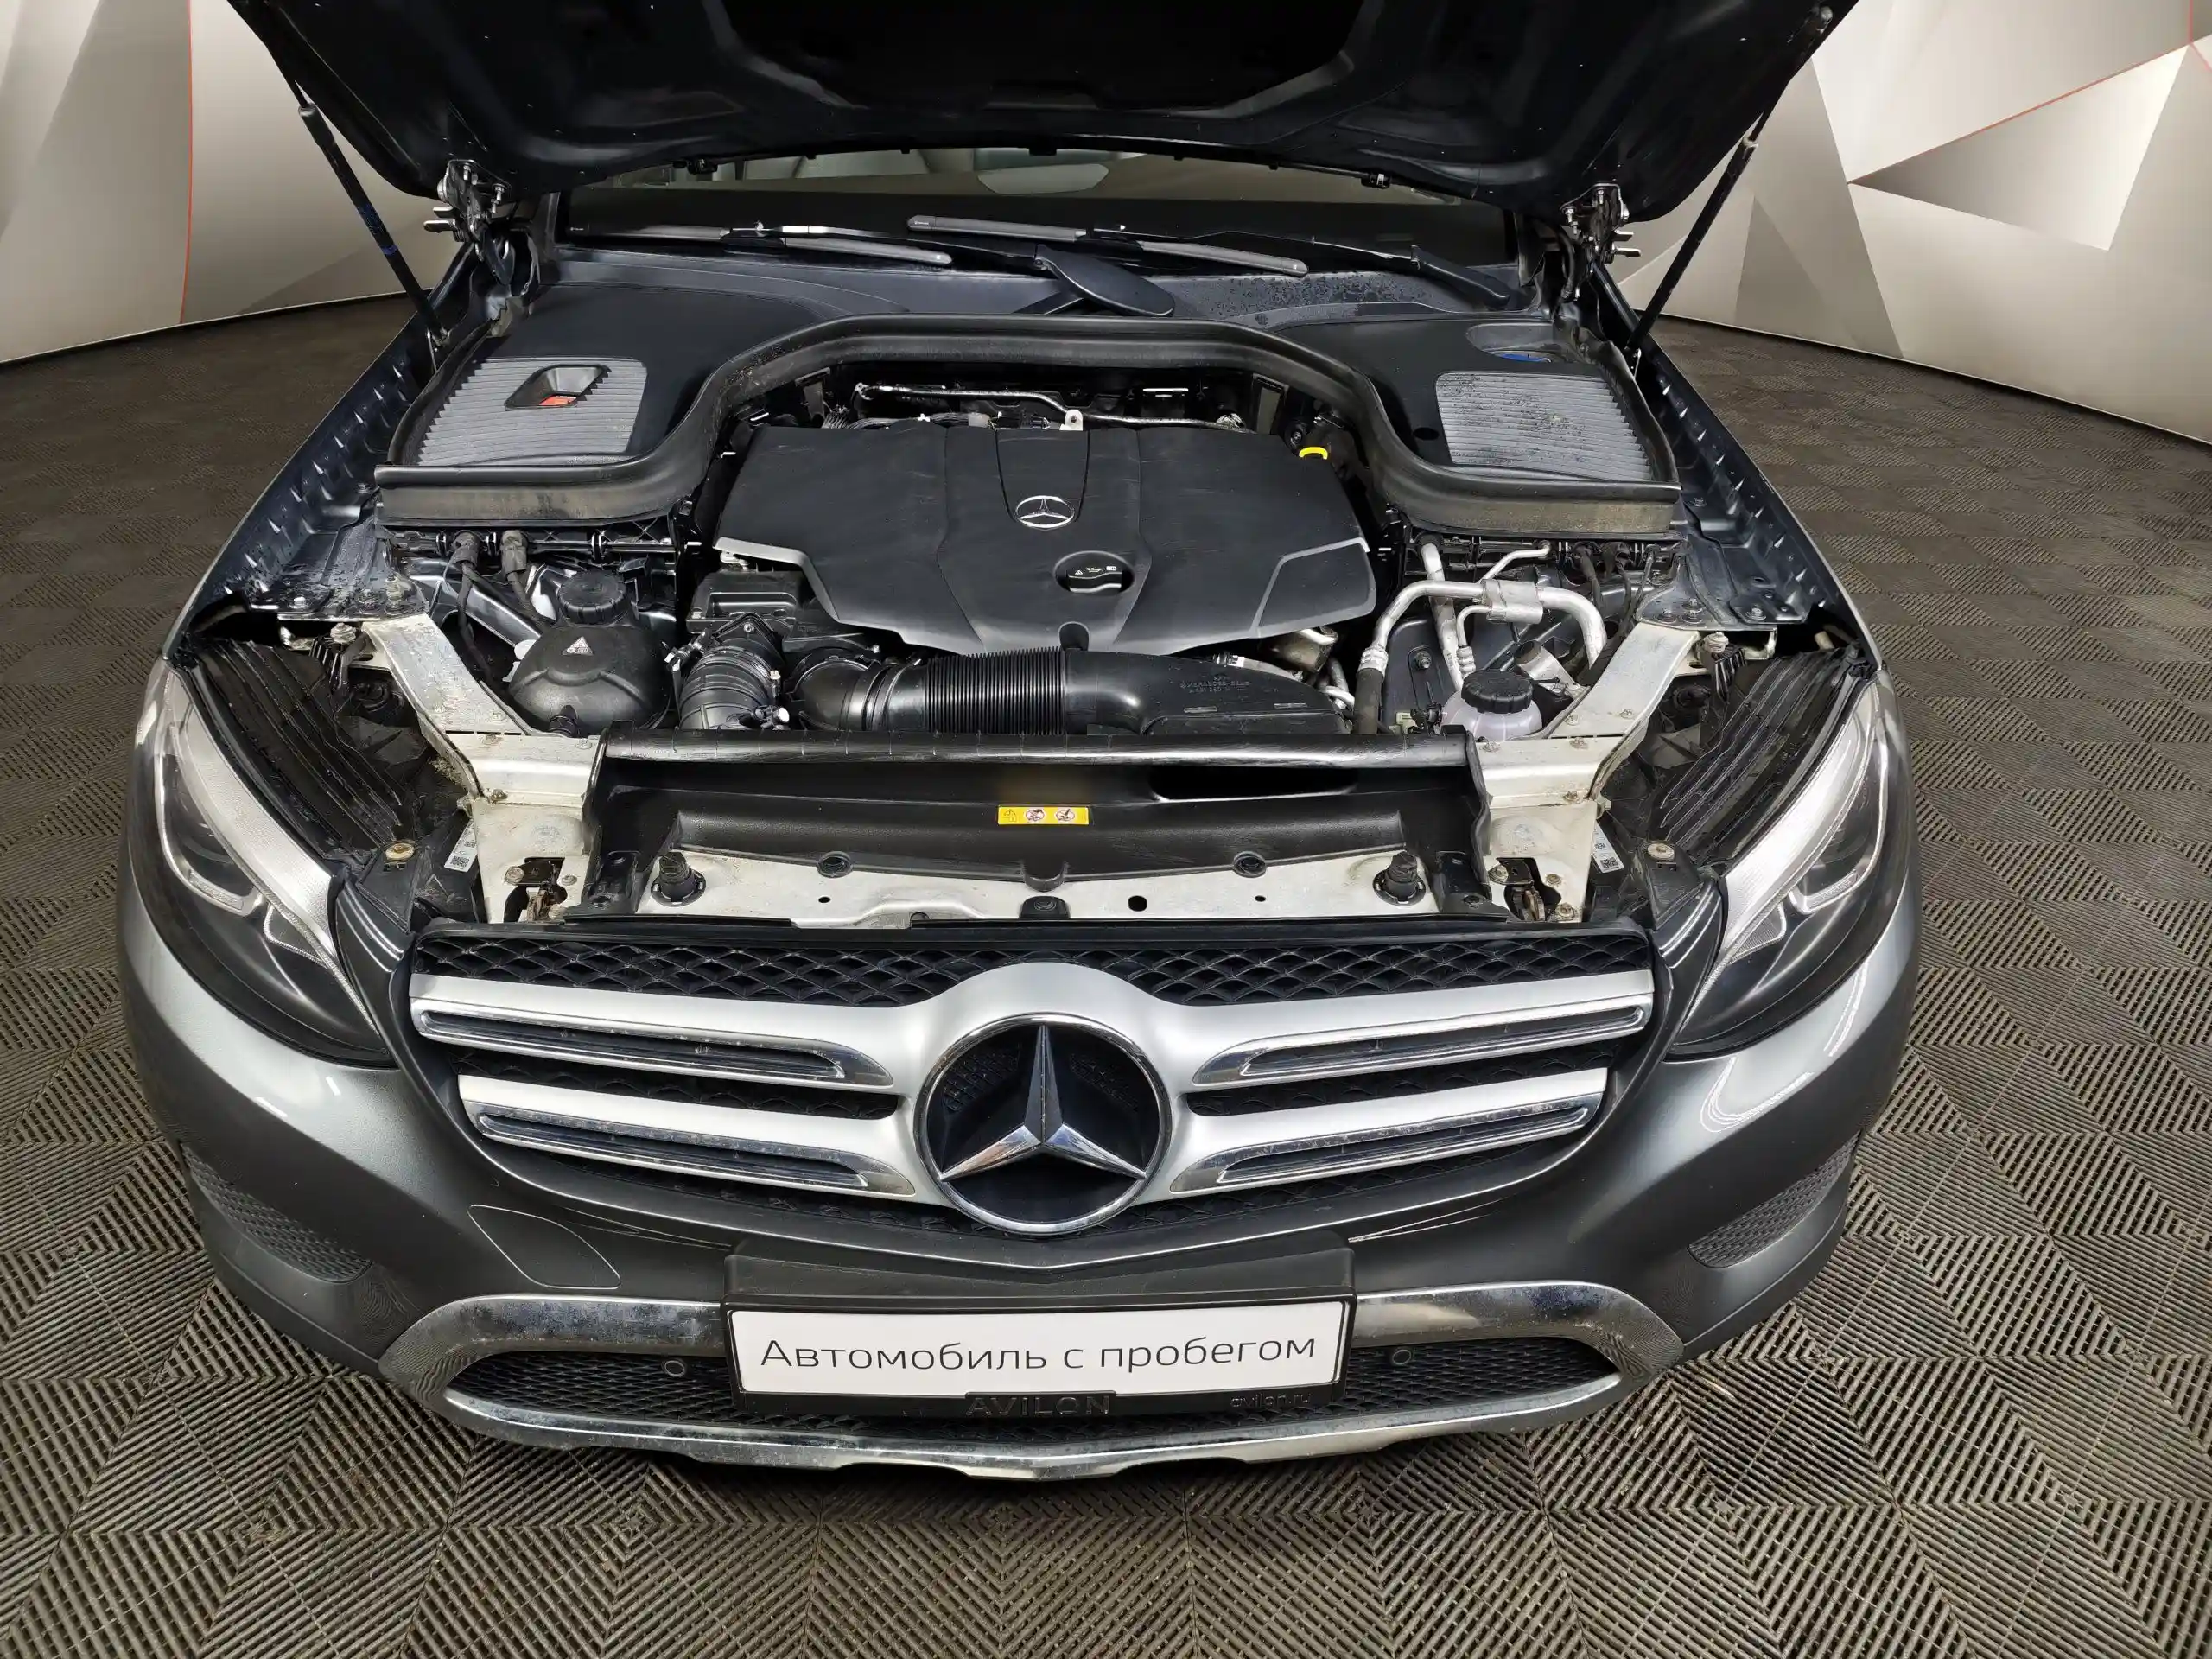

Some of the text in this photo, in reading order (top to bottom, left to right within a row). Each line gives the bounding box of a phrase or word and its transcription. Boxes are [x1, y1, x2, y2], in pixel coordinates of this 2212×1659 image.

[761, 1336, 1315, 1373] Автомобиль с пробегом
[965, 1395, 1110, 1416] AVILON
